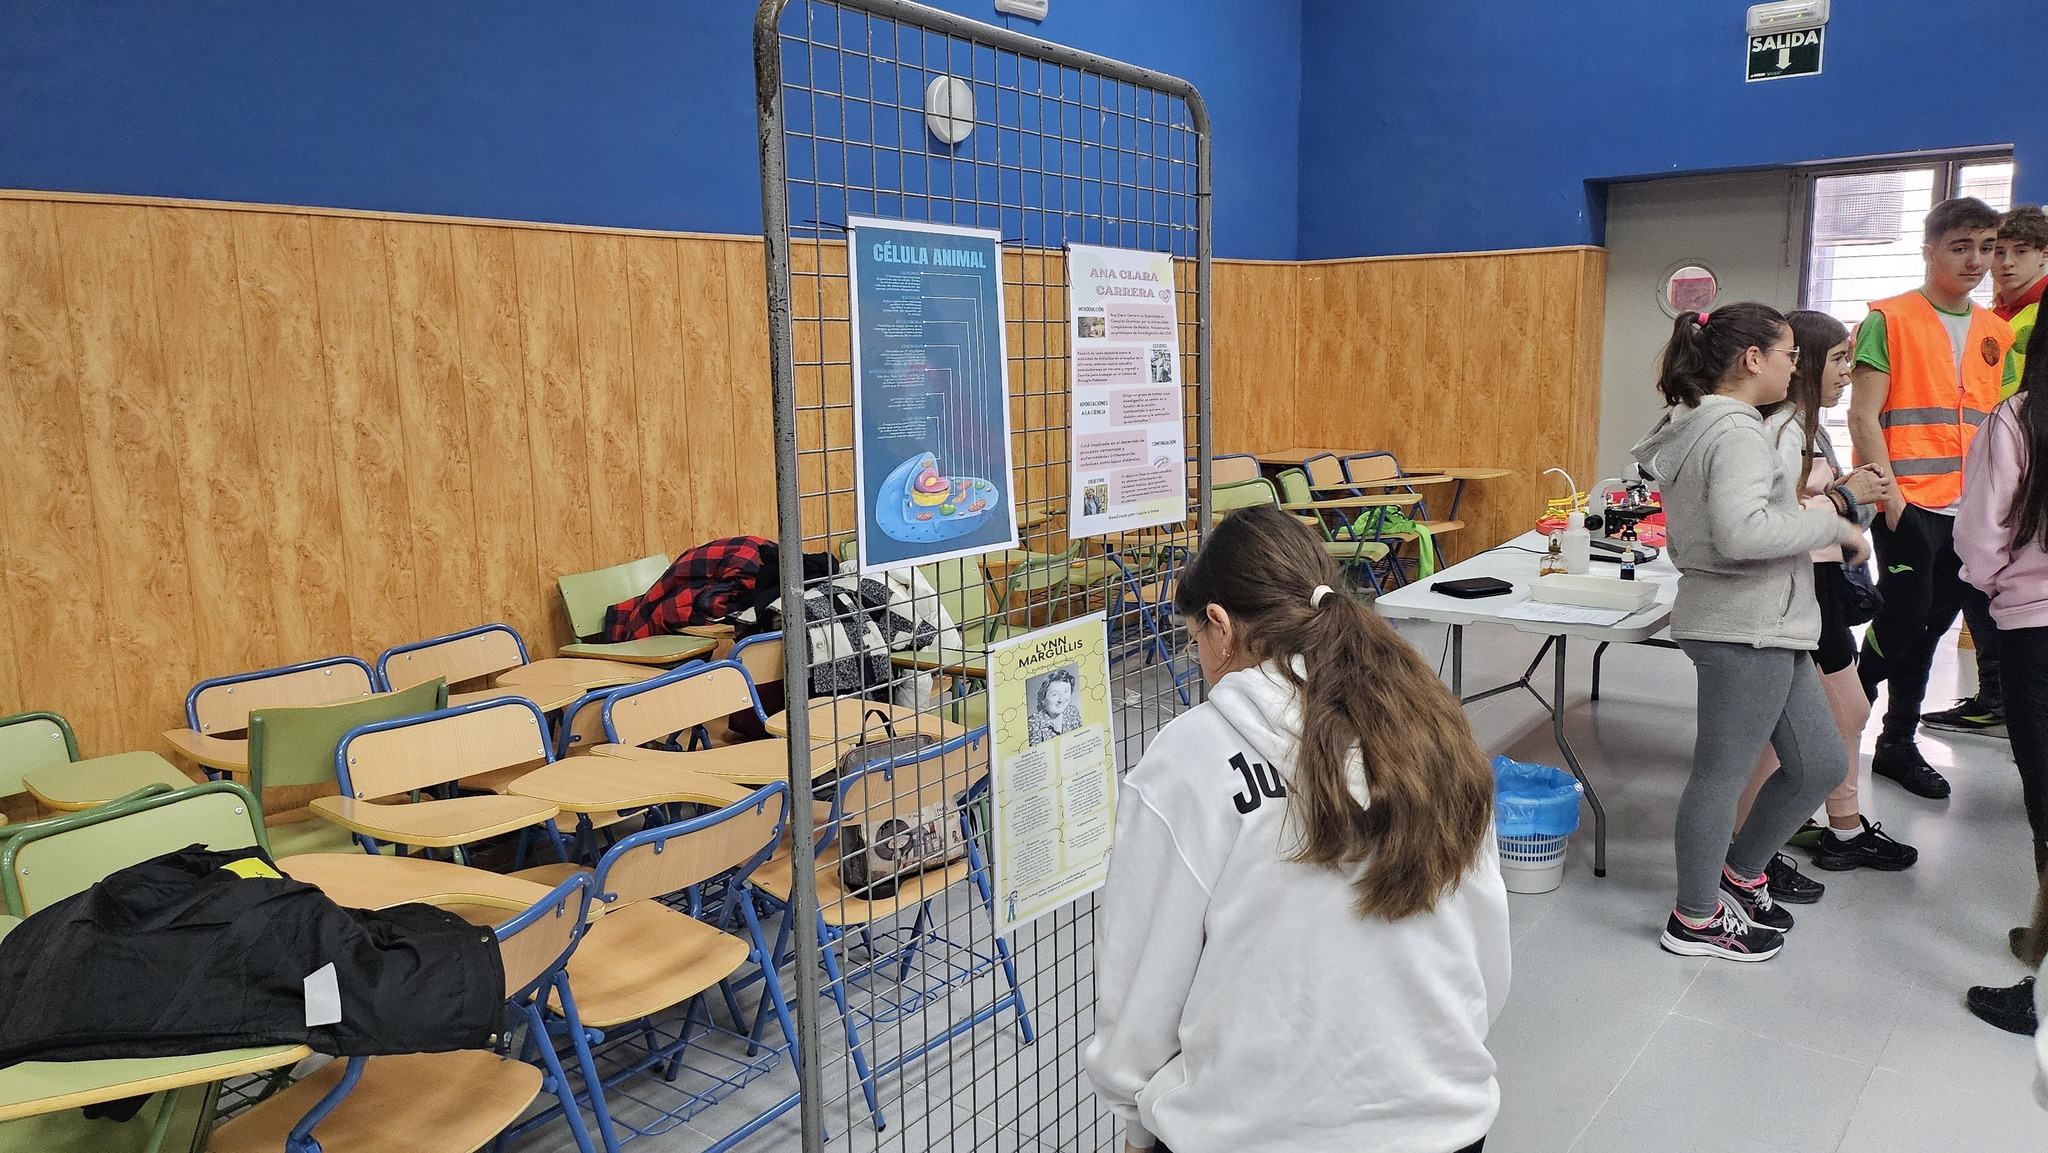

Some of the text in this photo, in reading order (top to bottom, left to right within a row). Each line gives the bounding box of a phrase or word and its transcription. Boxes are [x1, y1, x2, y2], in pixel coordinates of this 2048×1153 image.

[1751, 30, 1819, 53] SALIDA
[873, 240, 987, 269] CÉLULA ANIMAL
[1089, 268, 1159, 282] ANA CLARA
[1096, 286, 1155, 298] CARRERA
[1019, 640, 1083, 668] MARGULLIS
[1035, 636, 1067, 653] LYNN
